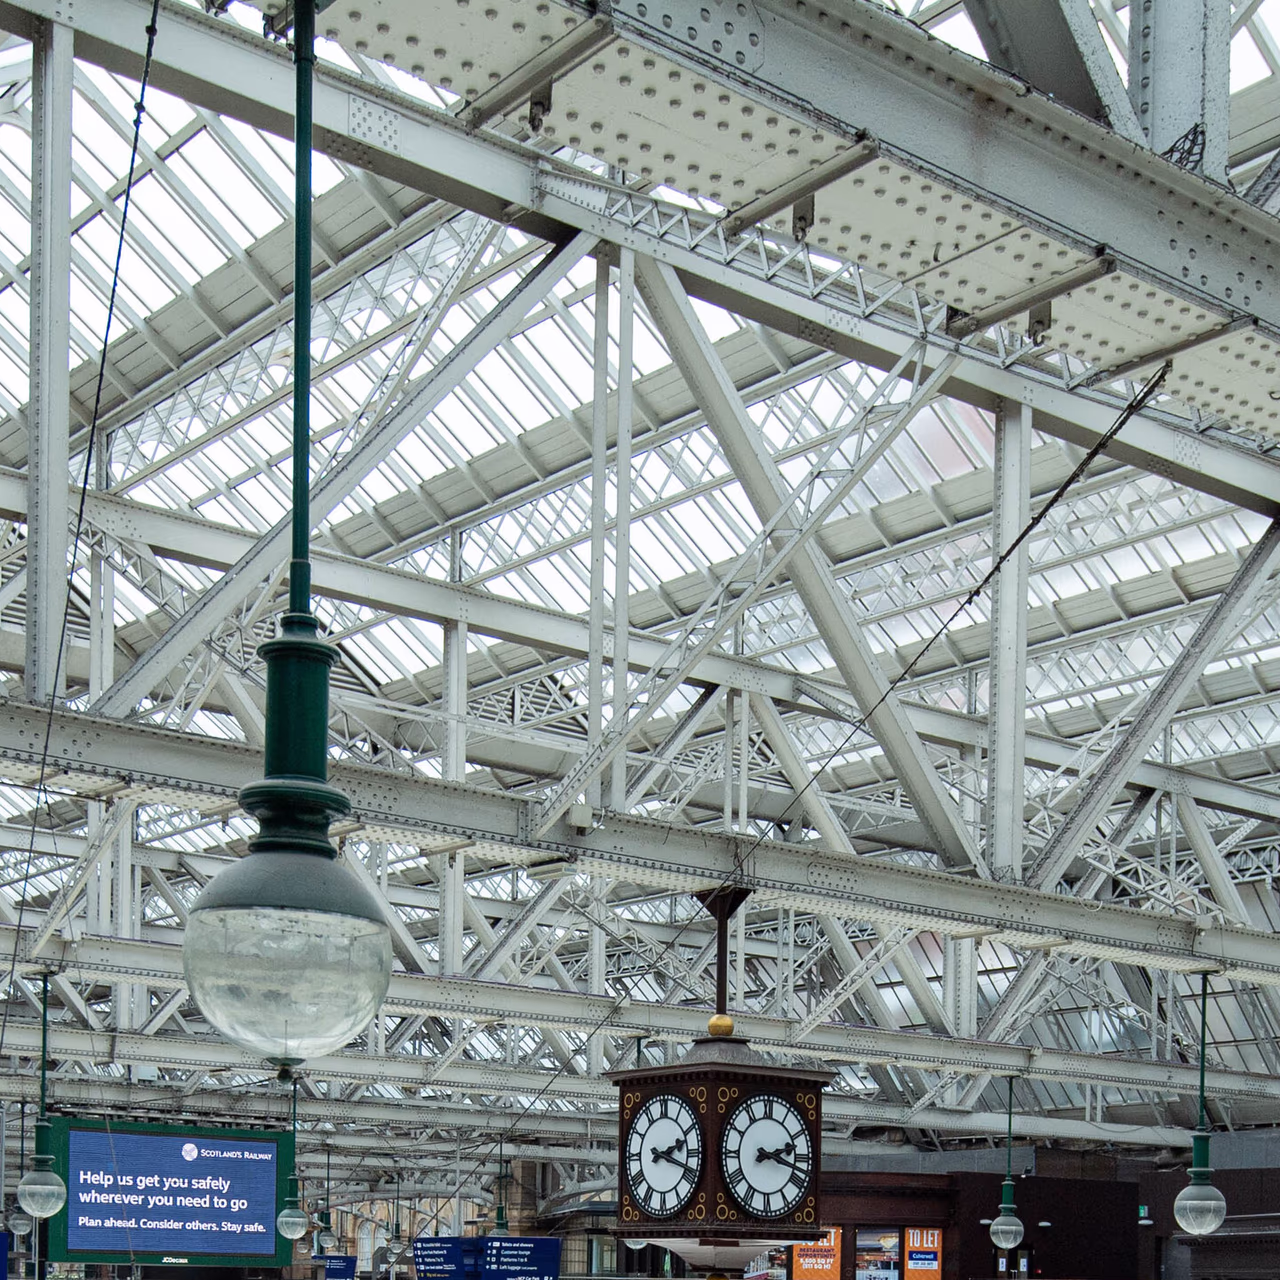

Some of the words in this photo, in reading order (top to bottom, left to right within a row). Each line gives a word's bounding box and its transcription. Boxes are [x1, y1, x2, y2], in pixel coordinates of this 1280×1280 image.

[79, 1171, 113, 1188] Help
[118, 1174, 134, 1185] us
[137, 1175, 160, 1189] get
[162, 1176, 188, 1190] you
[191, 1176, 230, 1193] safely
[79, 1190, 144, 1205] wherever
[147, 1195, 173, 1208] you
[177, 1194, 210, 1207] need
[214, 1196, 227, 1208] to
[230, 1198, 247, 1211] go
[79, 1216, 102, 1227] Plan
[104, 1217, 138, 1228] ahead.
[140, 1219, 184, 1230] Consider
[186, 1221, 219, 1231] others.
[221, 1221, 241, 1233] Stay
[244, 1222, 266, 1232] safe.
[909, 1230, 920, 1247] TO
[924, 1230, 939, 1247] LET
